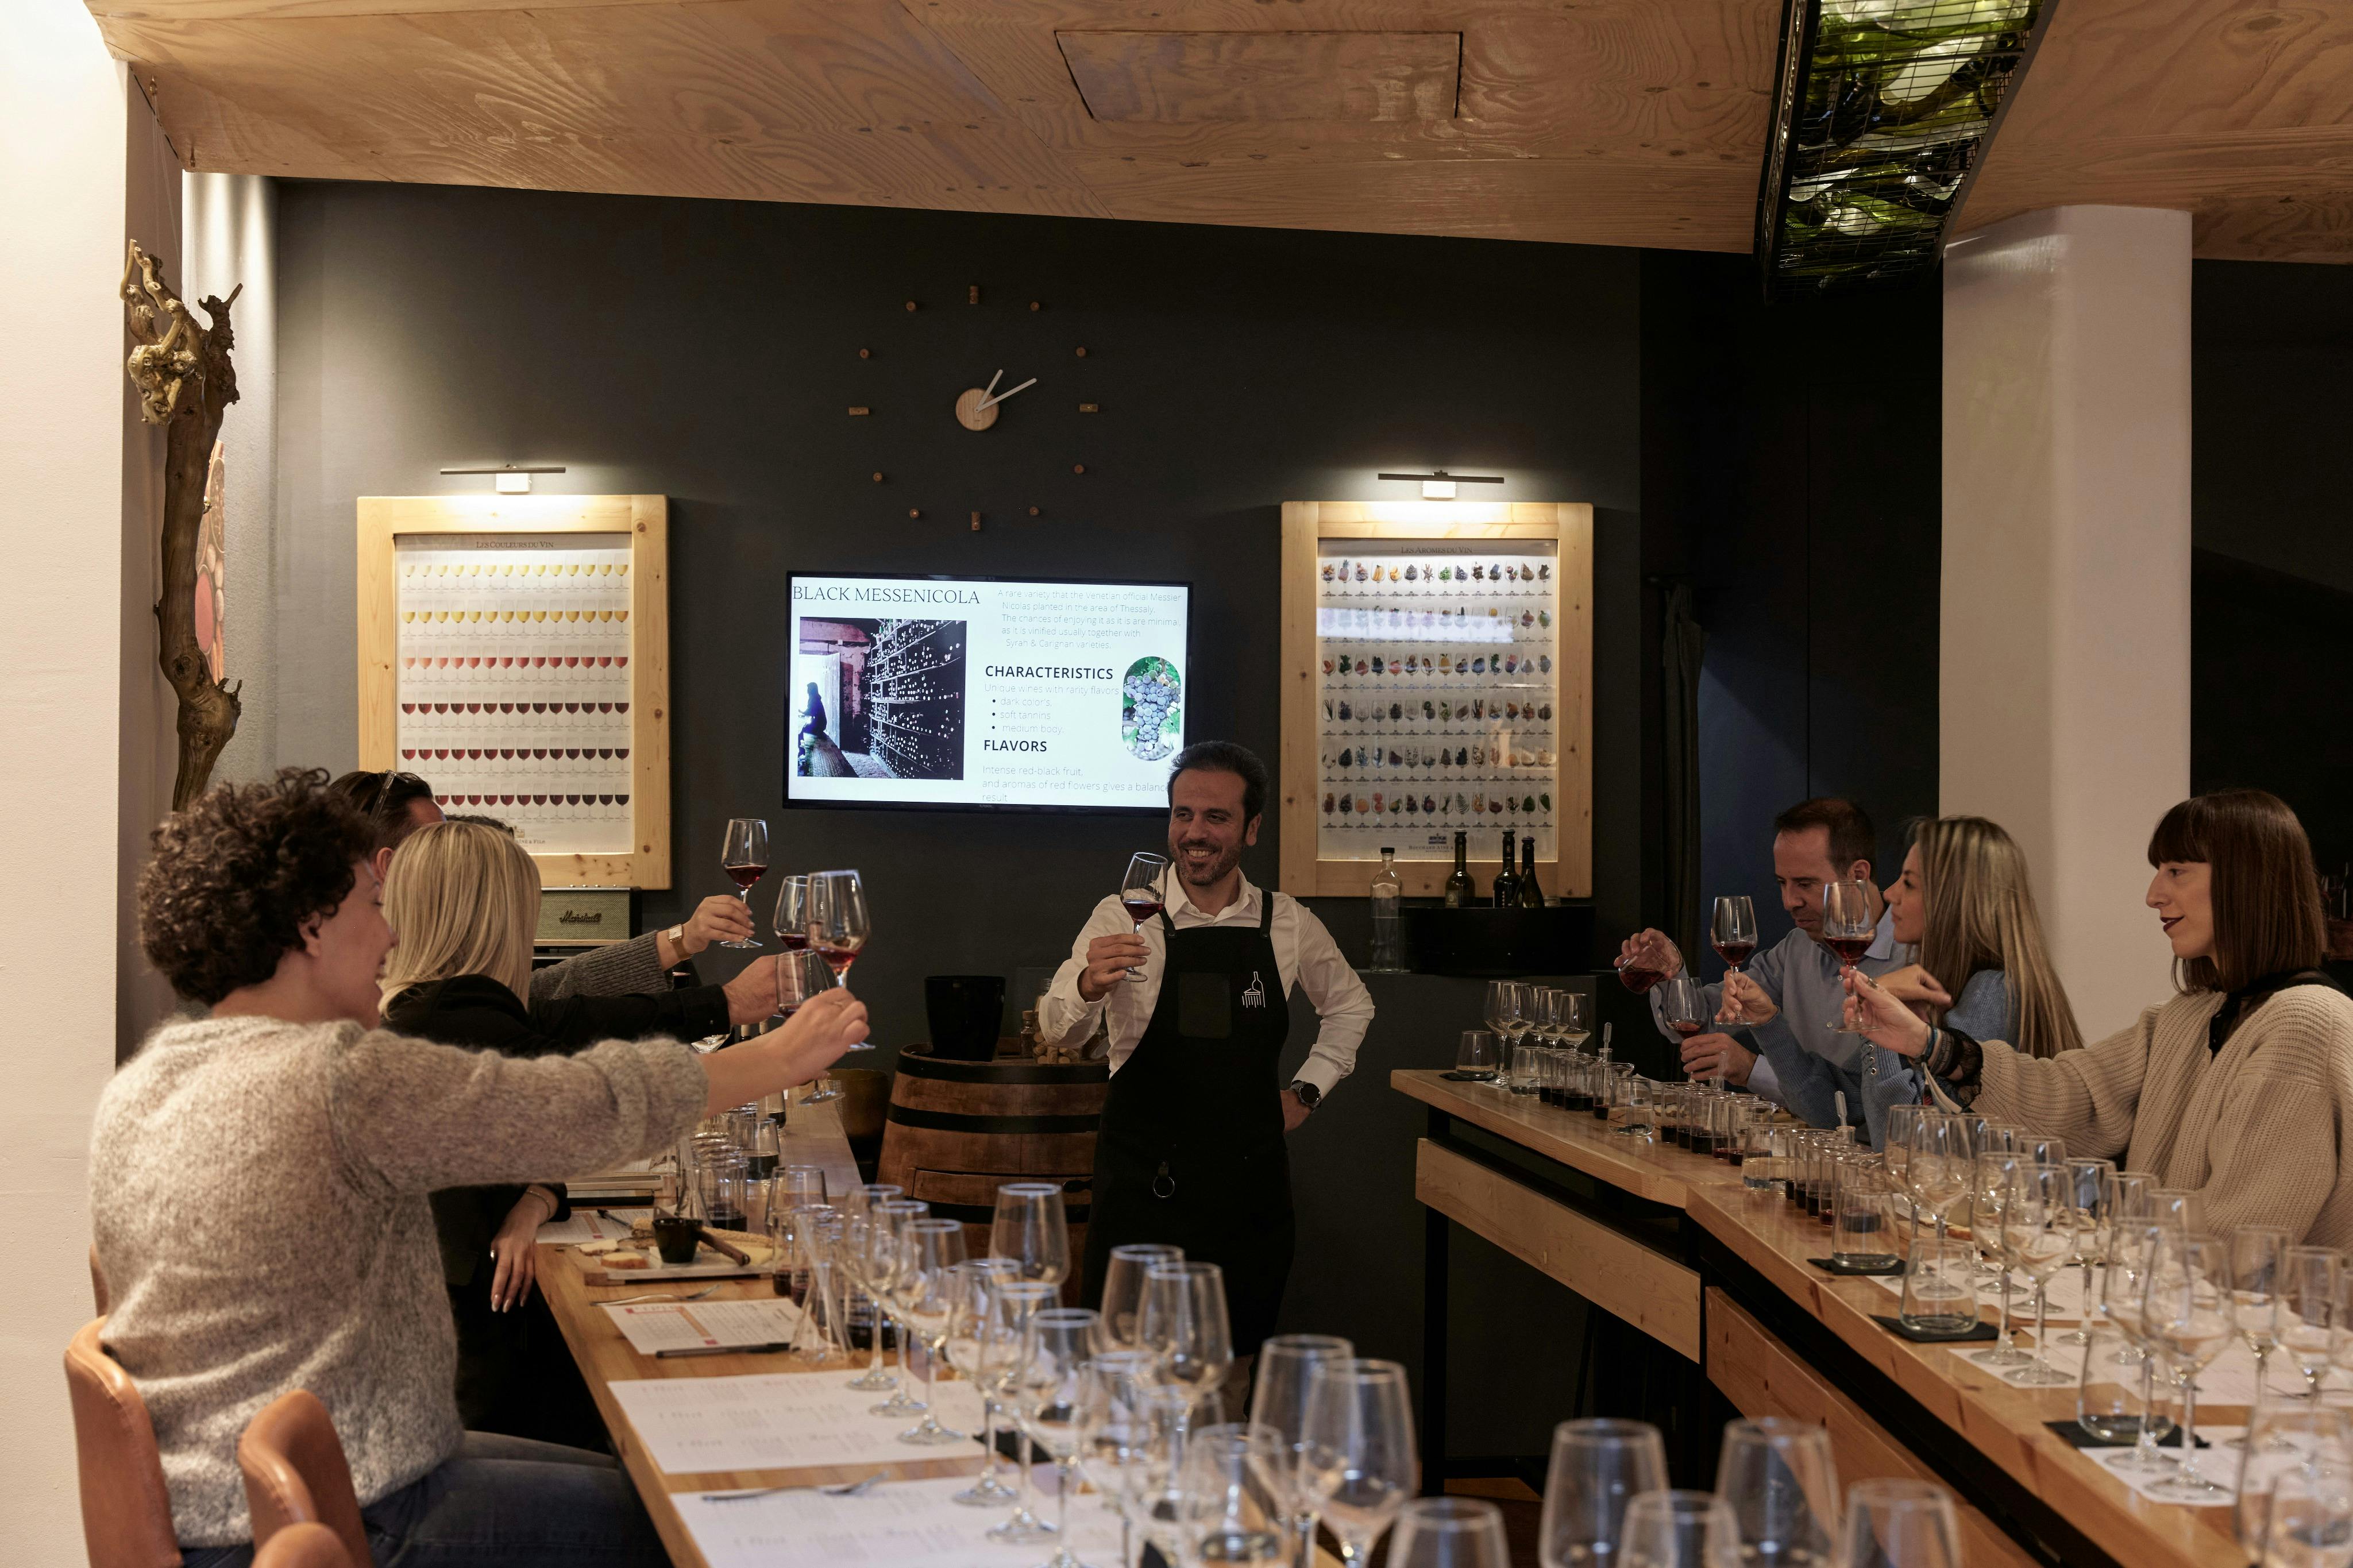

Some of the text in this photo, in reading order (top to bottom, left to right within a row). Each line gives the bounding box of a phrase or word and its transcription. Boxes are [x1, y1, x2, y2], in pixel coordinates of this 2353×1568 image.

[793, 586, 980, 604] BLACK MESSENICOLA
[1024, 591, 1050, 600] variety
[1033, 603, 1063, 612] planted
[1121, 605, 1155, 615] Thessaly.
[1064, 616, 1096, 625] enjoying
[1059, 628, 1086, 637] usually
[1087, 629, 1121, 638] together
[1006, 639, 1028, 648] Syrah
[1039, 640, 1074, 649] Carignan
[1075, 641, 1112, 649] varieties.
[985, 666, 1113, 679] CHARACTERISTICS
[984, 684, 1015, 693] Unique
[1066, 687, 1089, 696] rarity
[1091, 686, 1119, 695] flavors
[1001, 697, 1019, 705] dark
[1000, 710, 1016, 719] soft
[984, 740, 1047, 751] FLAVORS
[983, 766, 1083, 777] Intense red-black fruit,
[1039, 781, 1048, 789] of
[1050, 781, 1065, 789] red
[1068, 781, 1100, 790] flowers
[1103, 783, 1125, 792] gives
[982, 793, 1008, 802] result
[560, 910, 601, 923] Marshall
